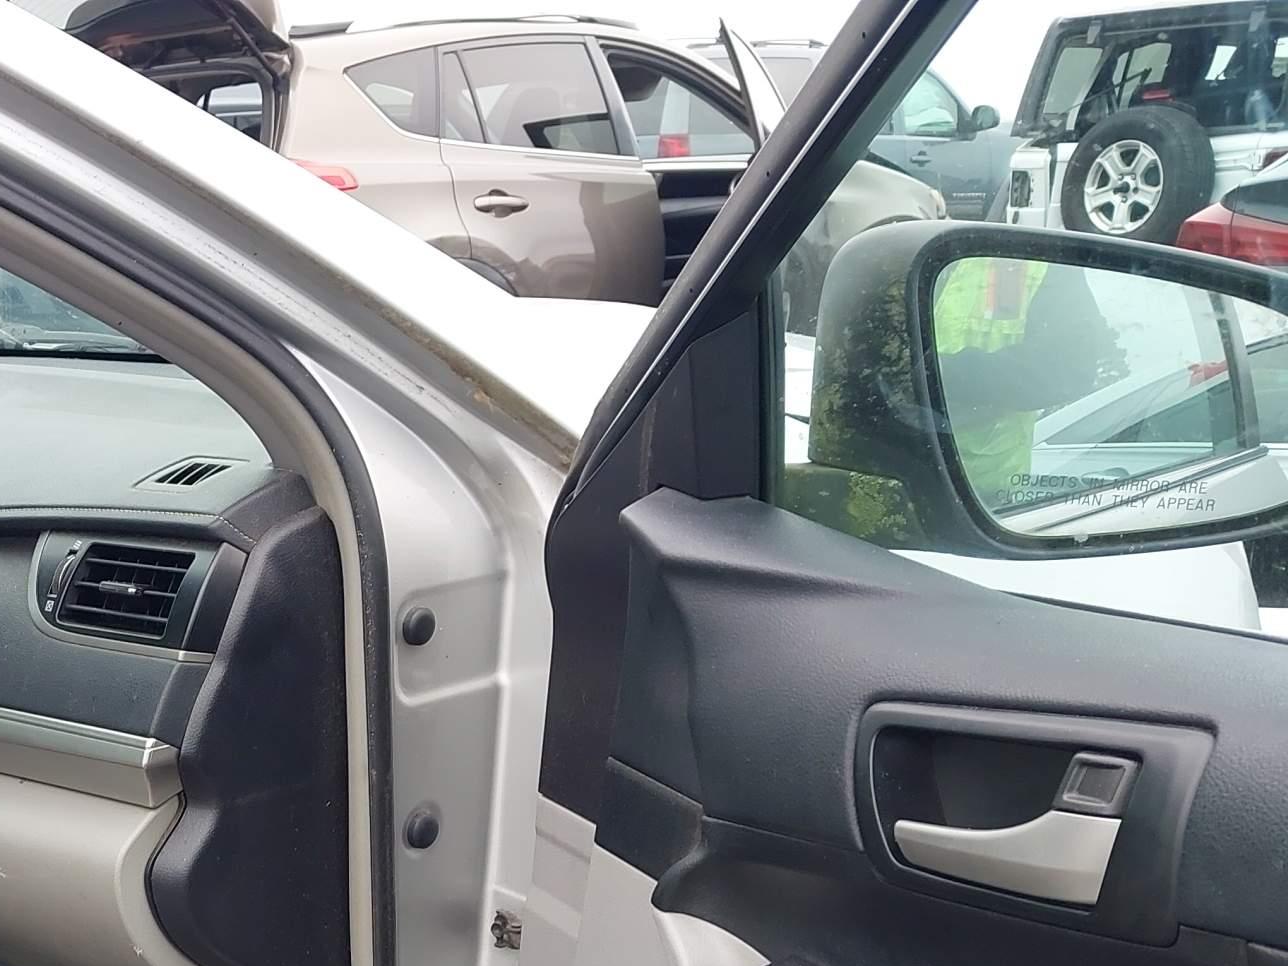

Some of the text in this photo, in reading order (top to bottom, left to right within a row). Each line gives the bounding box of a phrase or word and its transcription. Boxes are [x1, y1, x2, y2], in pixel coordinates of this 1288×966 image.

[1010, 473, 1209, 495] OBJECTS IN MIRROR ARE
[996, 488, 1217, 512] CLOSER THAN THEY APPEAR
